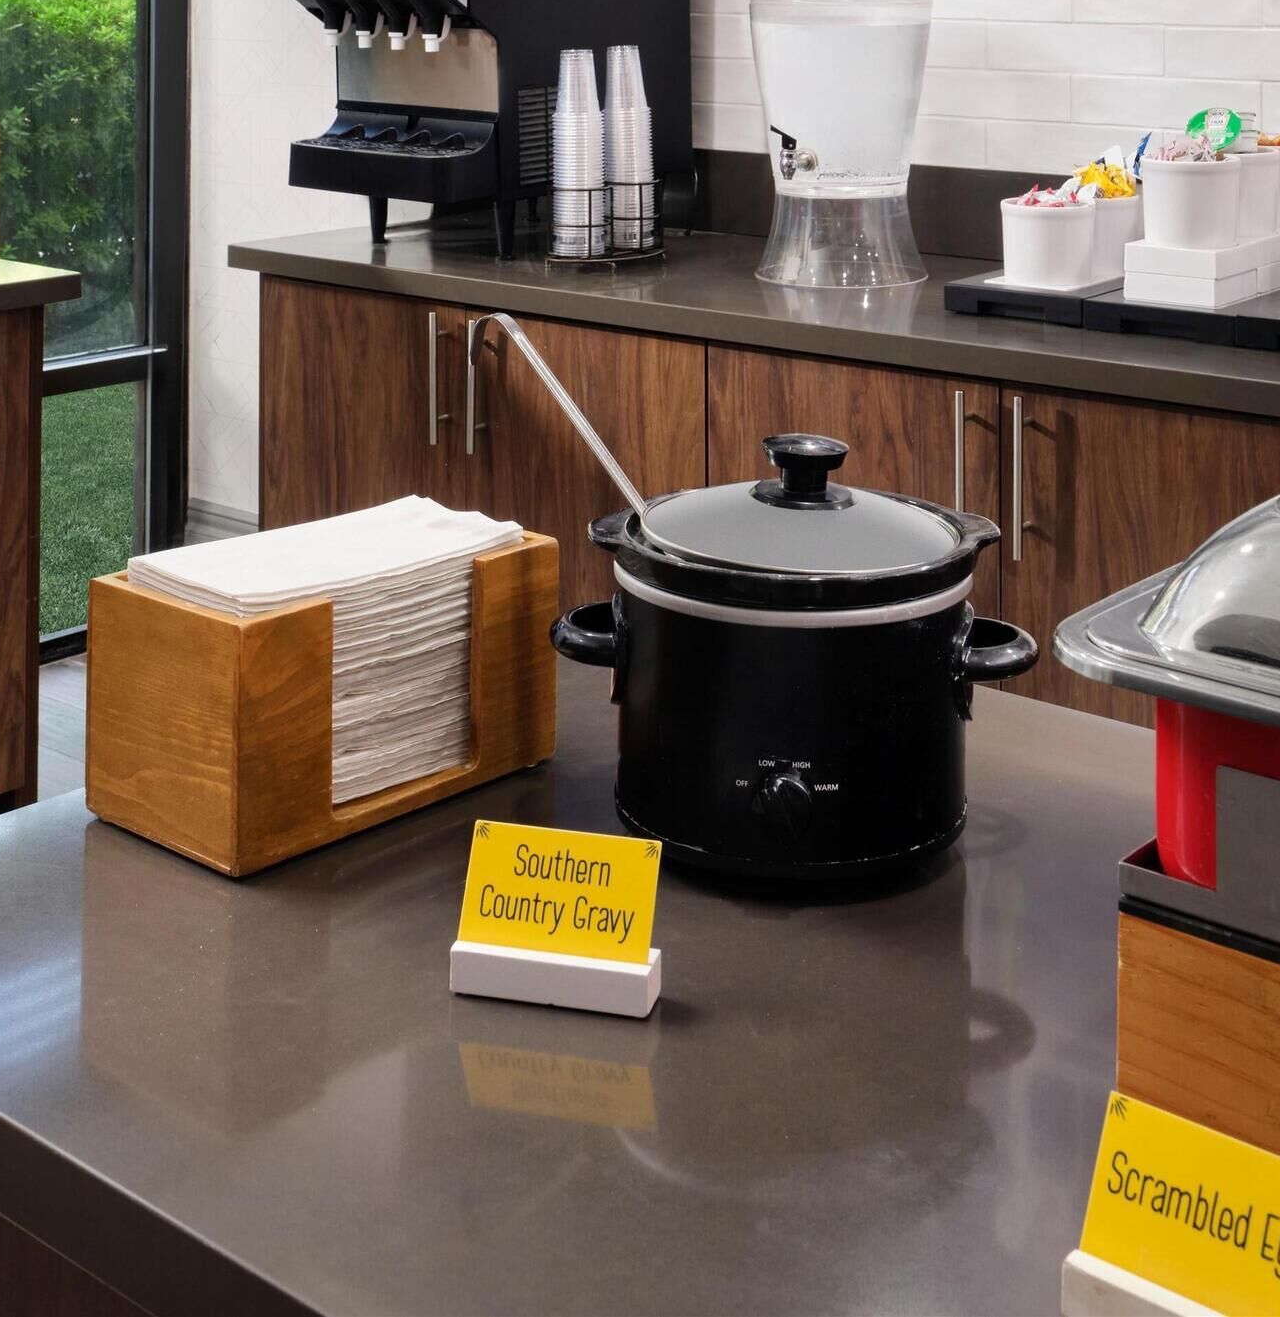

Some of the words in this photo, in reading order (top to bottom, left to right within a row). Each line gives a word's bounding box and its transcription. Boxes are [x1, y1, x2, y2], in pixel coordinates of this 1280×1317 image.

[758, 759, 776, 768] LOW
[792, 761, 811, 770] HIGH
[735, 779, 749, 788] OFF
[814, 783, 839, 792] WARM
[514, 844, 612, 888] Southern
[479, 884, 566, 936] Country
[573, 895, 636, 945] Gravy
[1107, 1150, 1253, 1251] Scrambled
